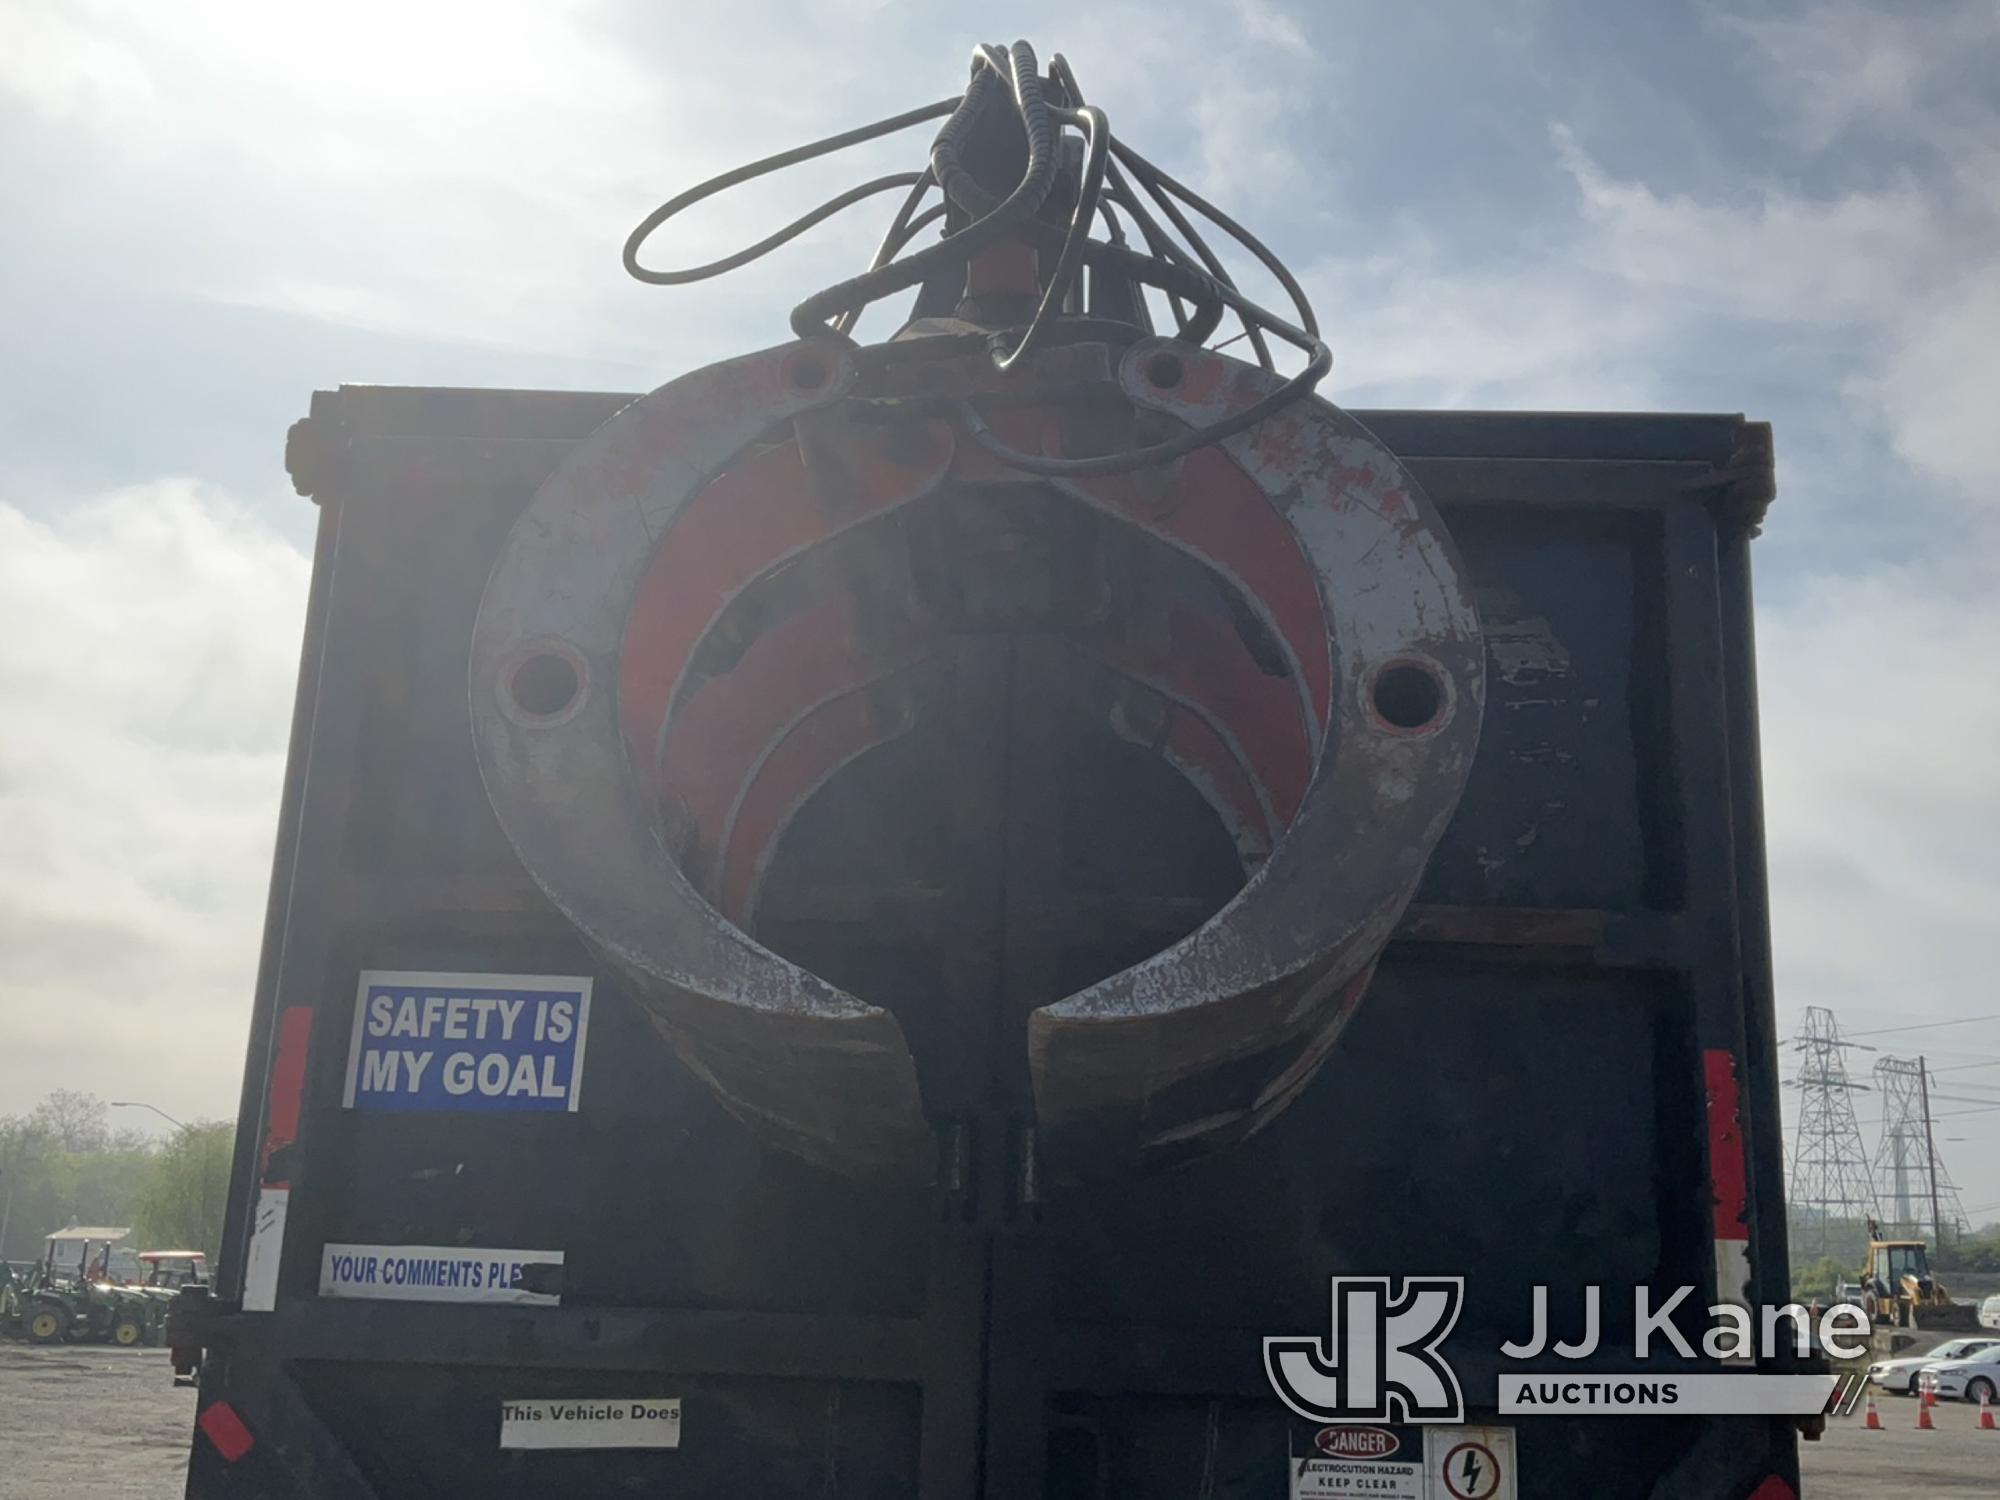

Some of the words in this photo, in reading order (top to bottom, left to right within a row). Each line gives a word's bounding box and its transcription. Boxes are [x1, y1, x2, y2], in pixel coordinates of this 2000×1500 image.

[367, 995, 525, 1041] SAFETY
[533, 1000, 573, 1043] IS
[361, 1049, 434, 1093] MY
[442, 1051, 567, 1098] GOAL
[331, 1255, 378, 1284] YOUR
[381, 1258, 483, 1288] COMMENTS
[503, 1405, 543, 1421] This
[550, 1405, 624, 1420] Vehicle
[631, 1404, 680, 1420] Does
[1328, 1431, 1387, 1452] DANGER
[1302, 1463, 1376, 1475] LECTROCUTION
[1377, 1465, 1414, 1476] HAZARD
[1318, 1477, 1351, 1487] KEEP
[1356, 1478, 1397, 1489] CLEAR
